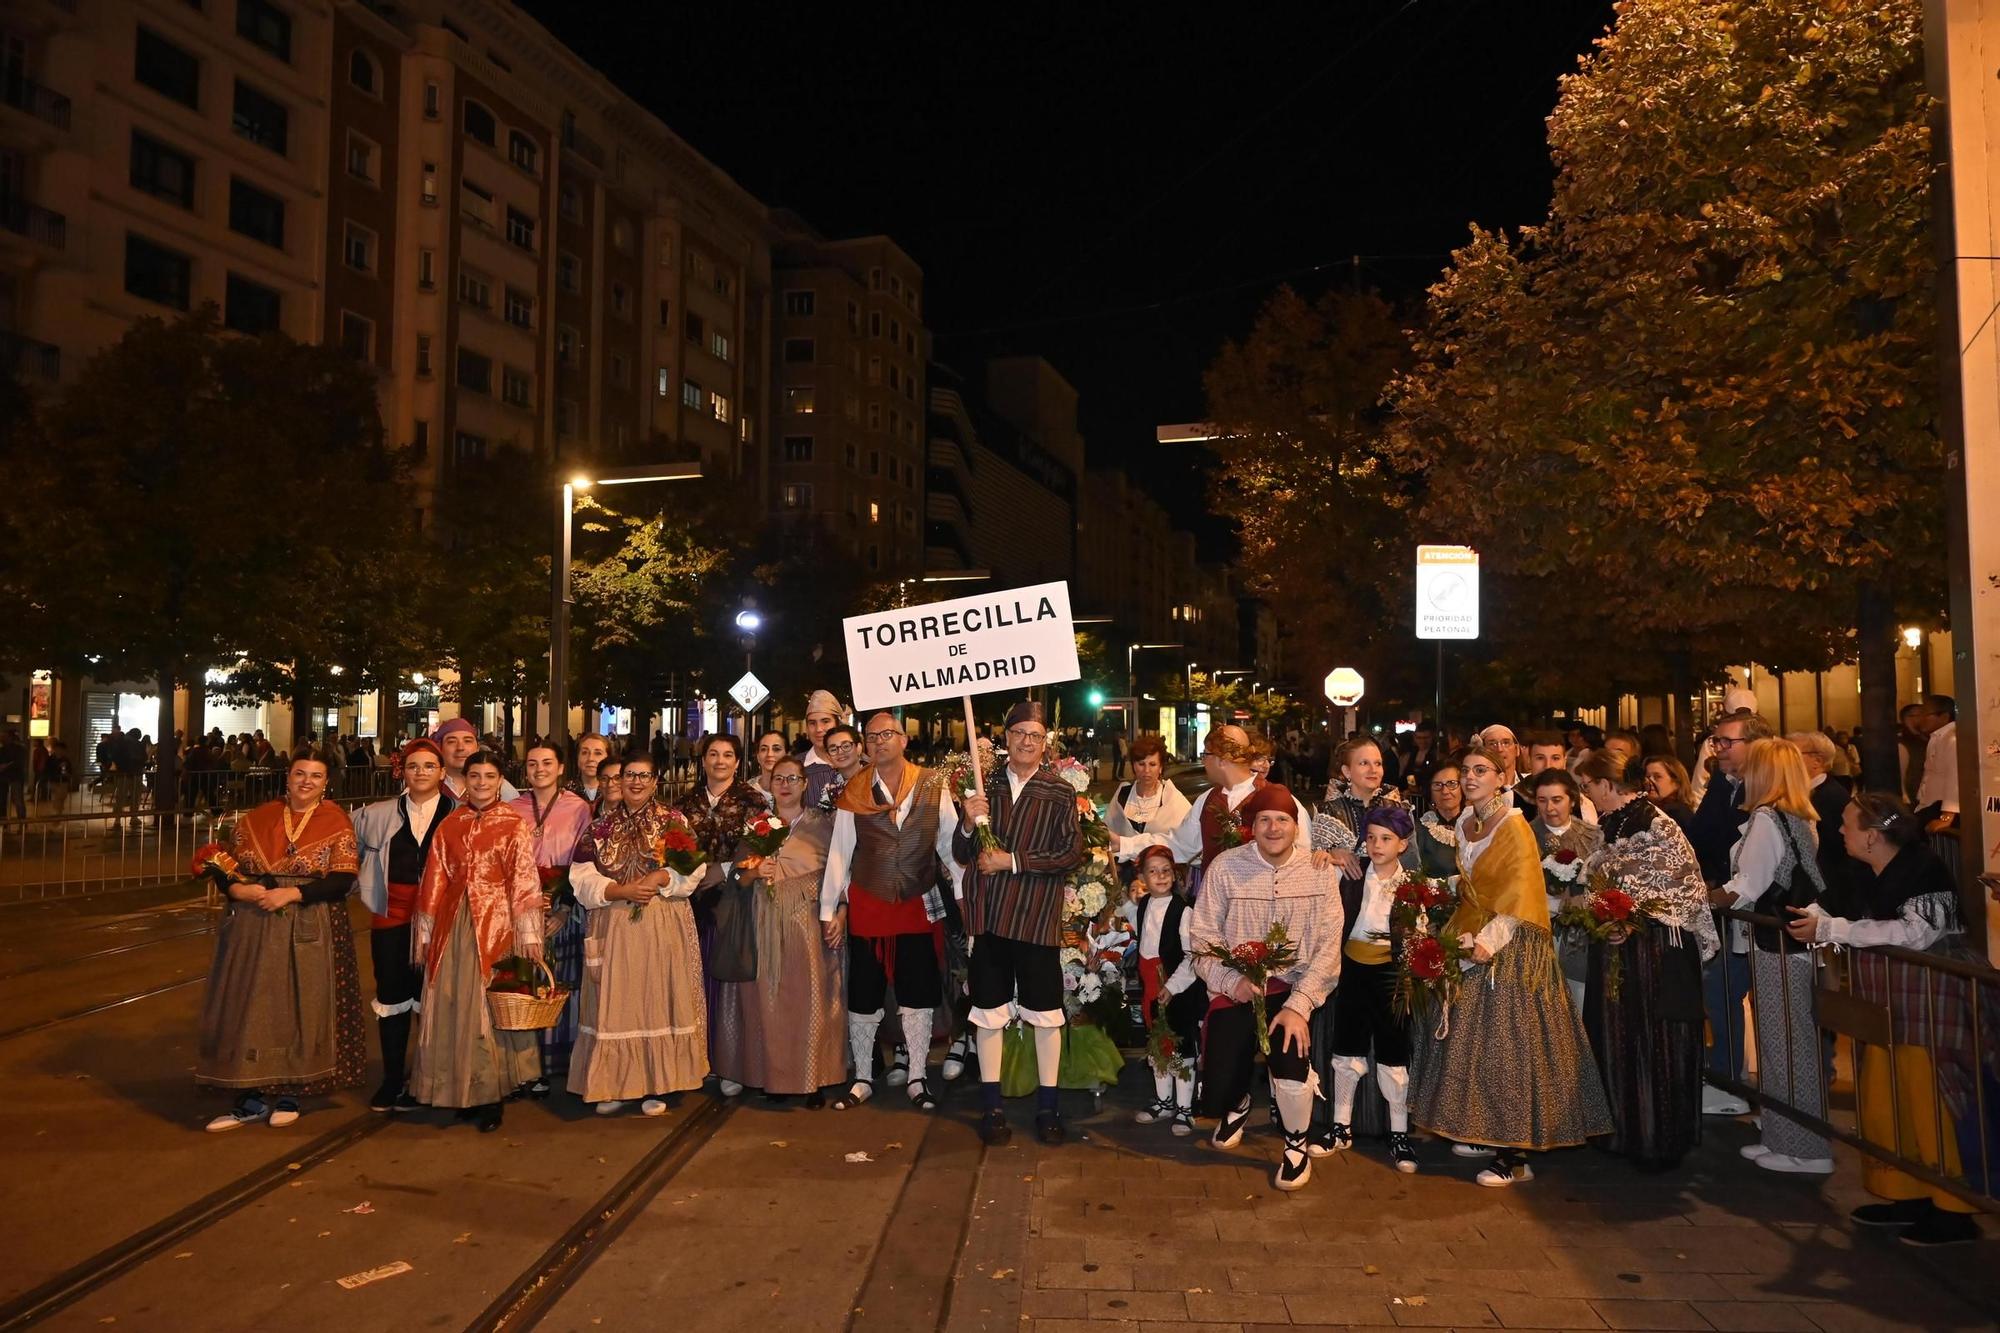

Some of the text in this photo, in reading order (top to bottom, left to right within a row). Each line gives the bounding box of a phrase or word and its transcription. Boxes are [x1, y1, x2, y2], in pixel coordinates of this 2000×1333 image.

[857, 596, 1057, 649] TORRECILLA
[1423, 615, 1472, 623] PRIORIDAD
[948, 643, 968, 657] DE
[889, 654, 1037, 693] VALMADRID
[740, 685, 758, 699] 30
